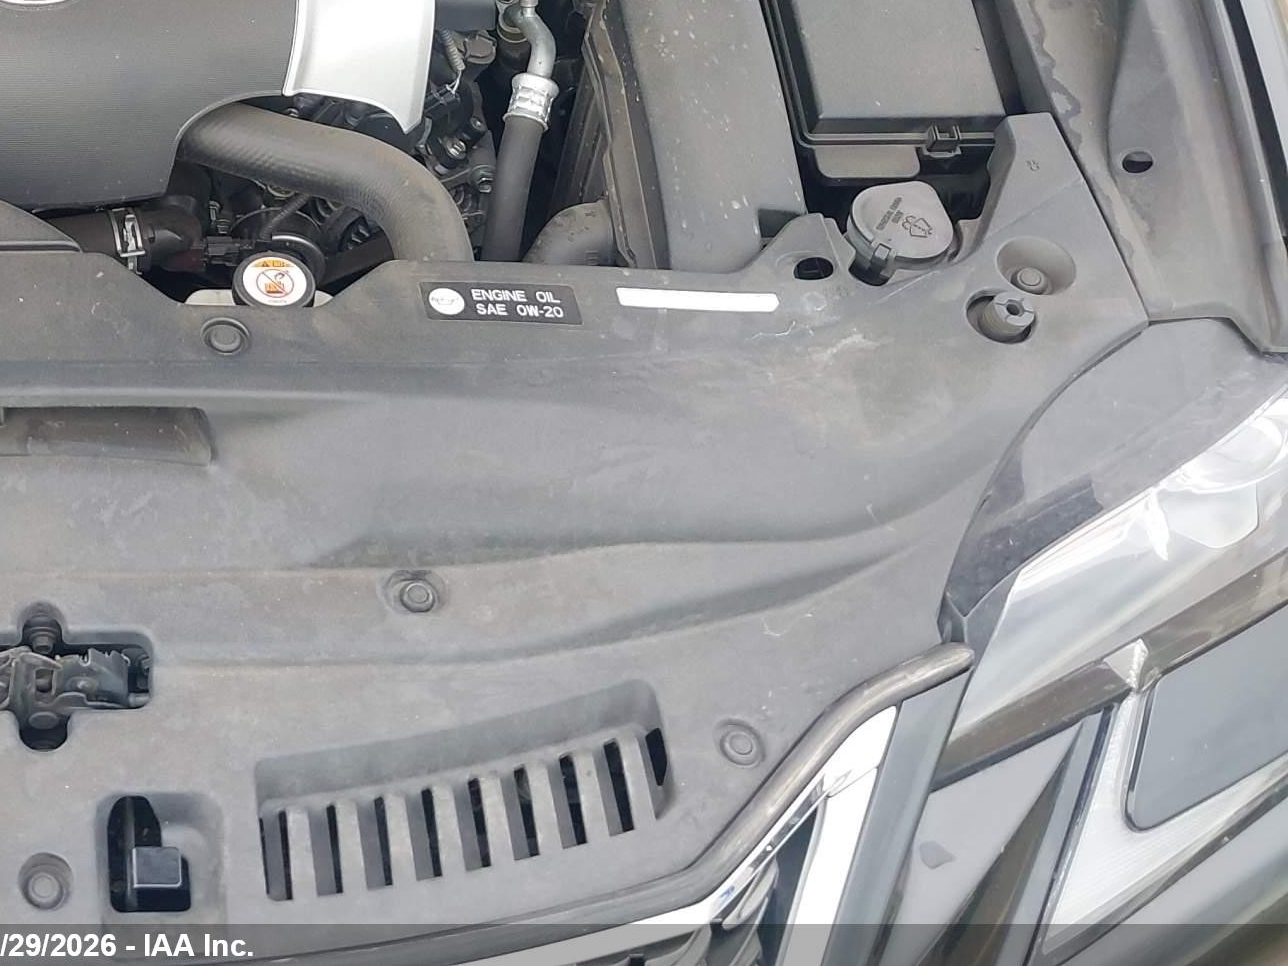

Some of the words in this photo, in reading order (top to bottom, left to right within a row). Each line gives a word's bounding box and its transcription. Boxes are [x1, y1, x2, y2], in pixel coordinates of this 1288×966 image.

[471, 288, 528, 302] ENGINE
[535, 291, 561, 303] OIL
[477, 303, 509, 316] SAE
[516, 305, 564, 318] 0W-20
